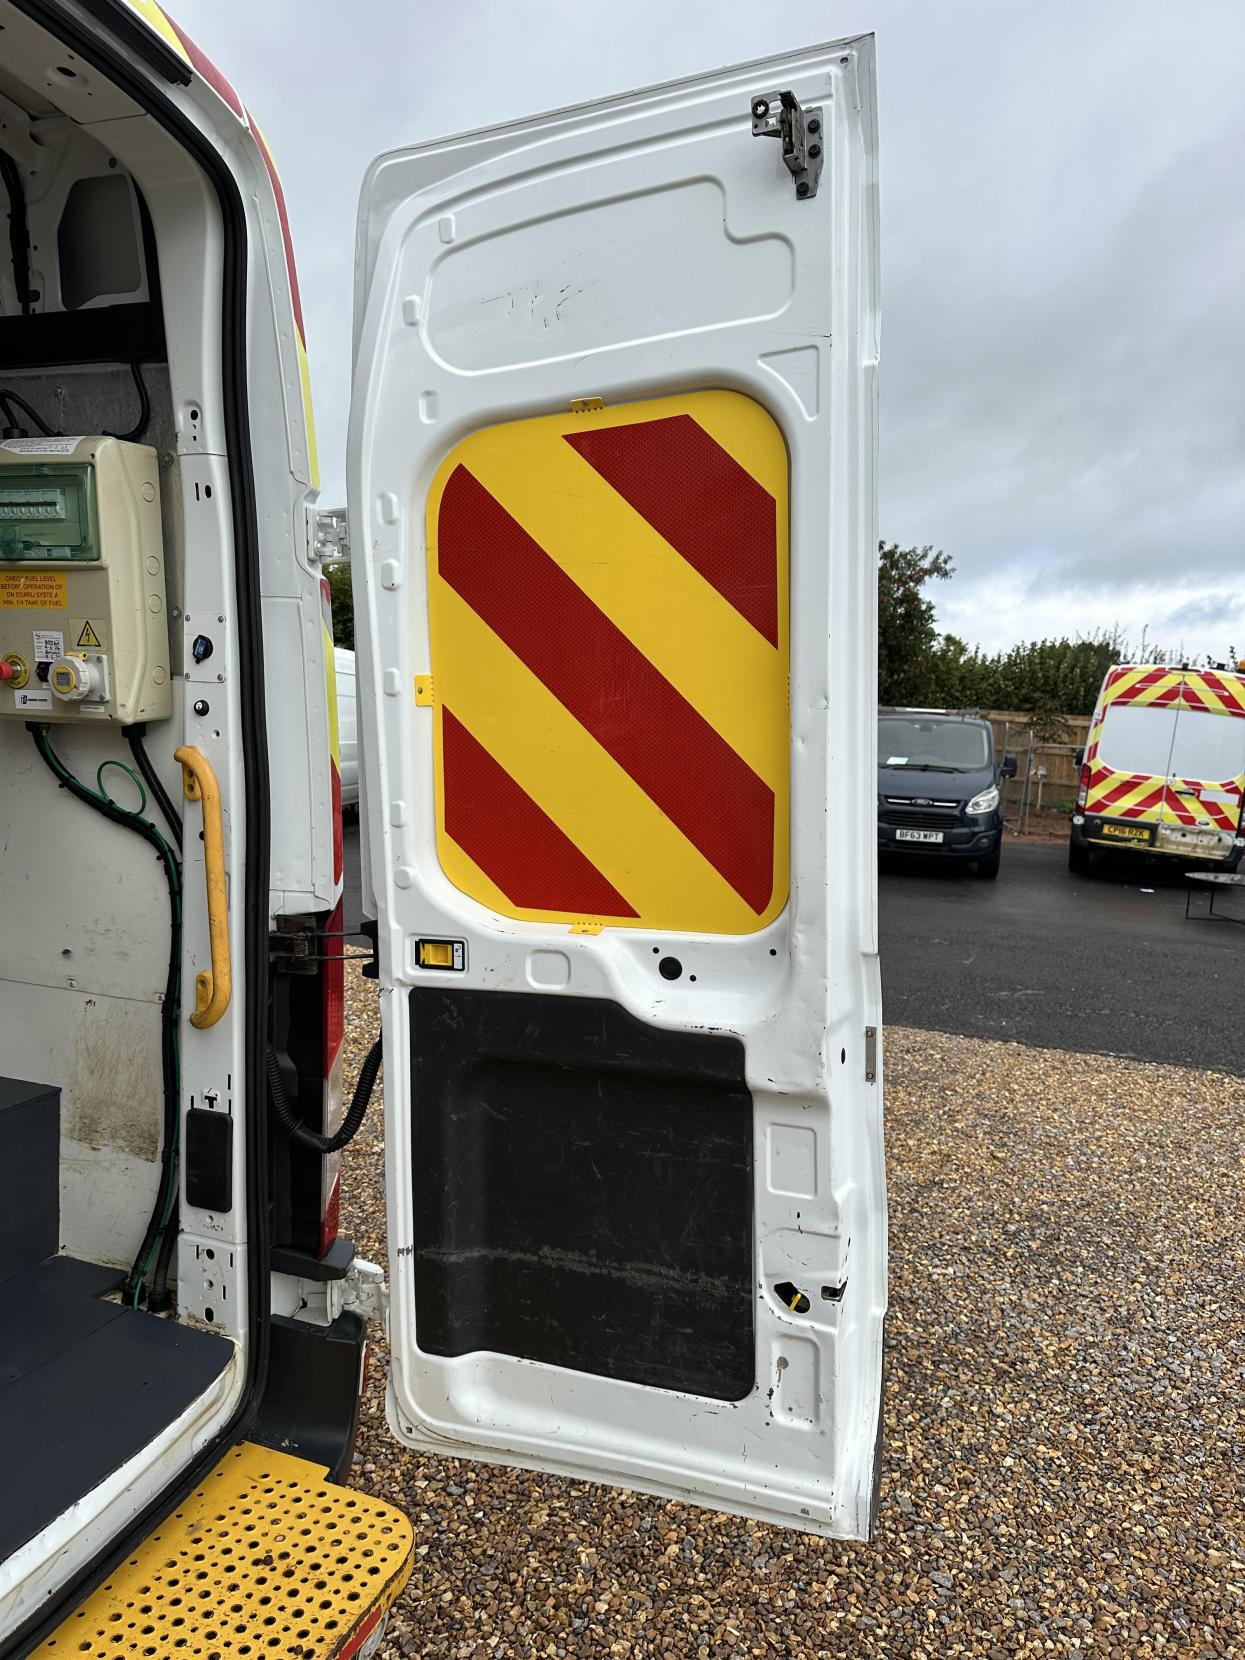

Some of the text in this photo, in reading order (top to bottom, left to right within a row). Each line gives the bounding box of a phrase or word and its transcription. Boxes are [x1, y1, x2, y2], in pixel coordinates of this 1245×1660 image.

[899, 831, 939, 841] BF63 WPT
[1107, 825, 1145, 838] CP16 RZK
